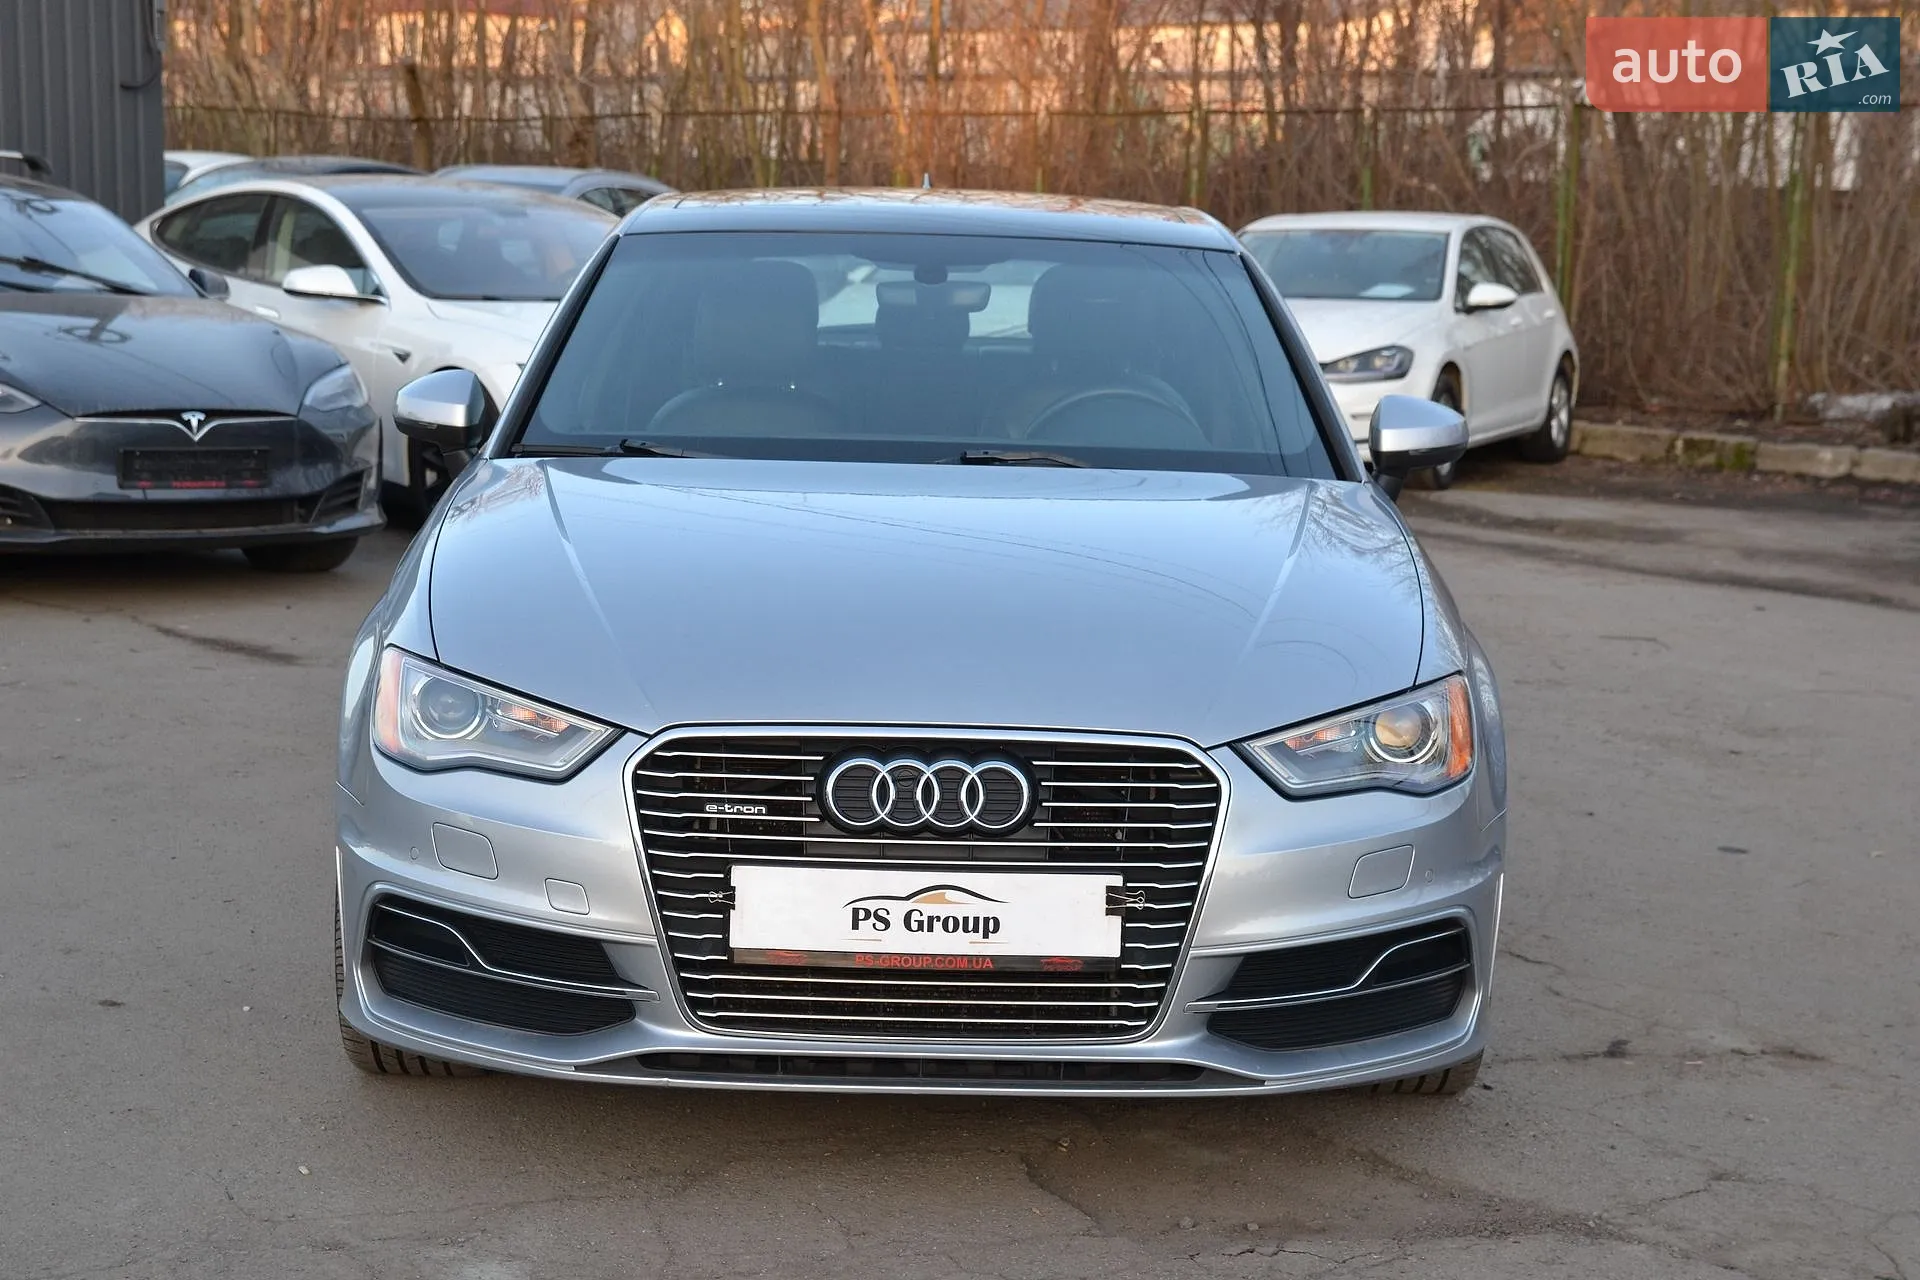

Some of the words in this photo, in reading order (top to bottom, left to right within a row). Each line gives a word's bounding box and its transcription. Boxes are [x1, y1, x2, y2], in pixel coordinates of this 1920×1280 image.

[705, 803, 766, 814] e-tron
[851, 907, 891, 931] PS
[903, 908, 1001, 939] Group
[855, 953, 994, 969] PS-GROUP.COM.UA
